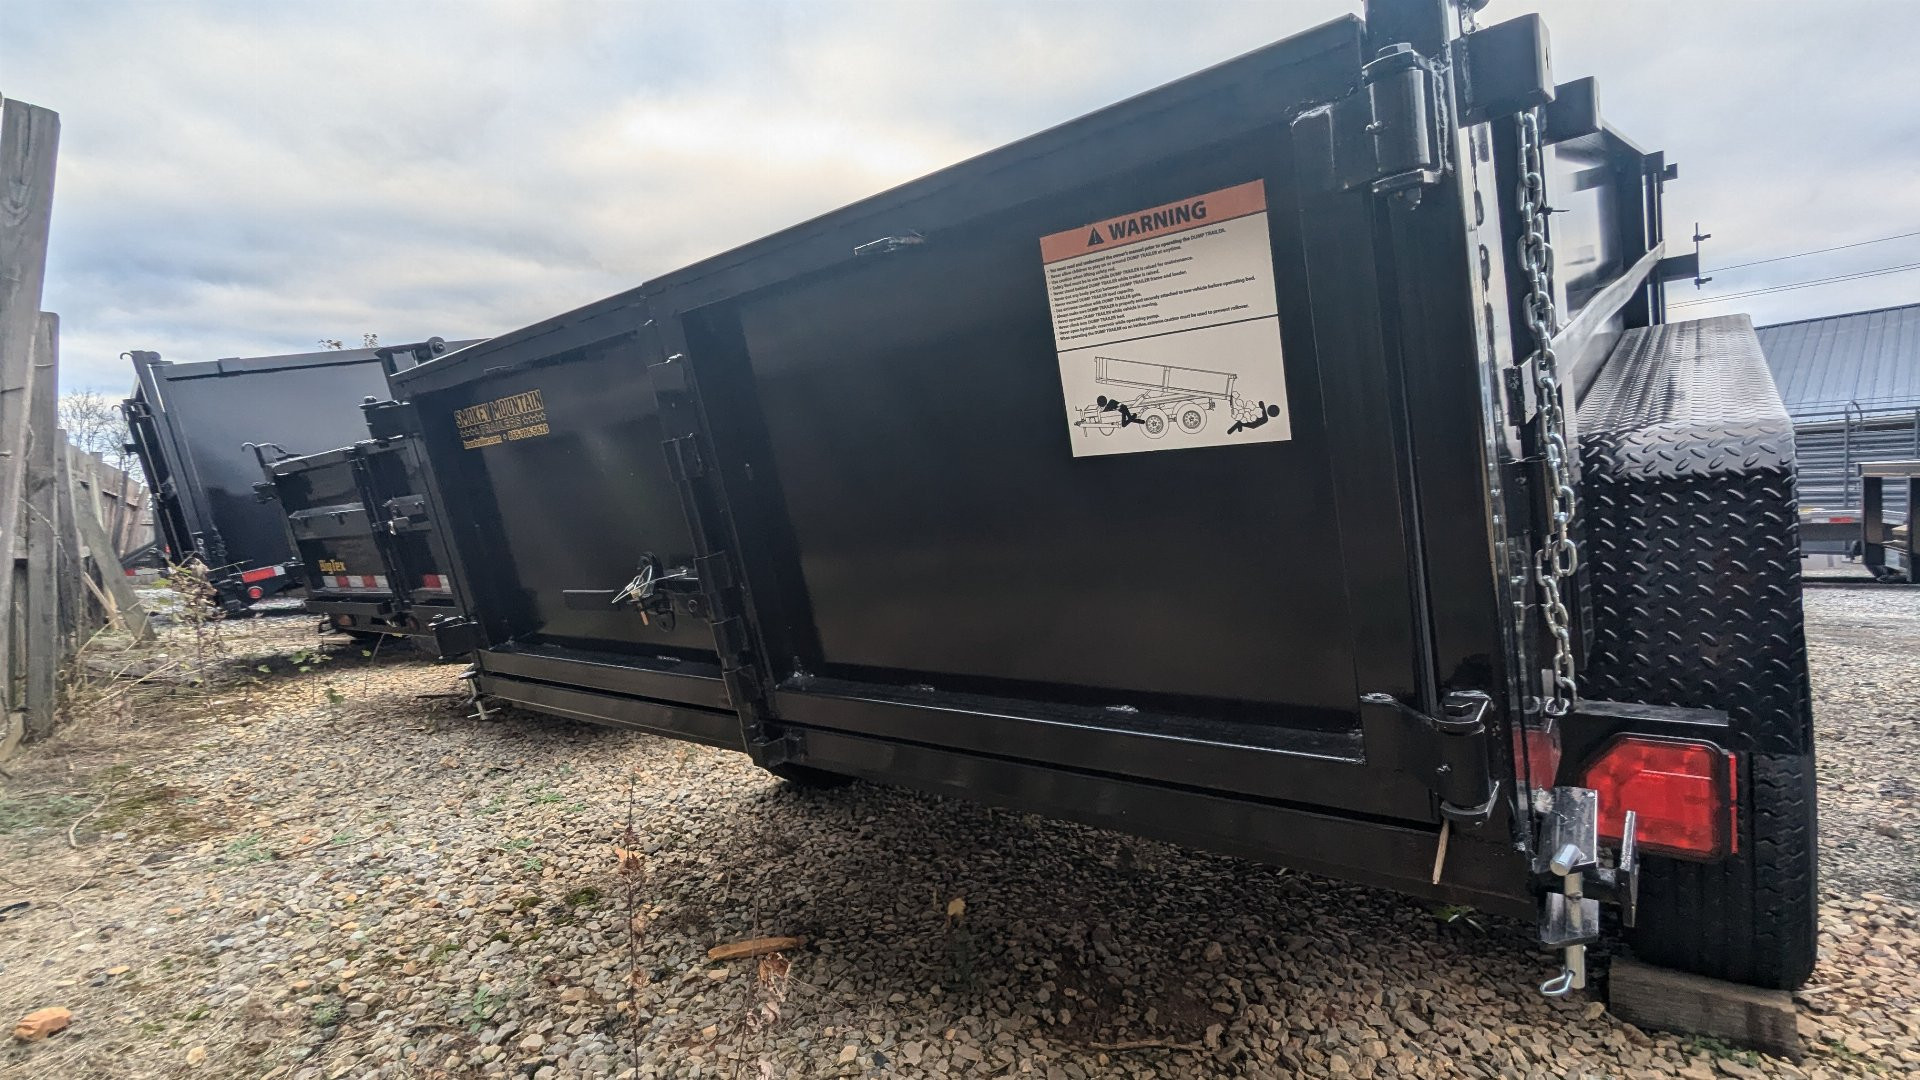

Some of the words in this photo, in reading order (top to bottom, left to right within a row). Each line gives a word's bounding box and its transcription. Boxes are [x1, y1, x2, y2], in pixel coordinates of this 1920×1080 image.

[1108, 200, 1207, 241] WARNING
[1140, 250, 1158, 258] TRAILER
[1123, 267, 1140, 275] TRAILER
[454, 403, 491, 428] SMOKEY
[490, 389, 544, 421] MOUNTAIN
[479, 416, 522, 434] TRAILERS
